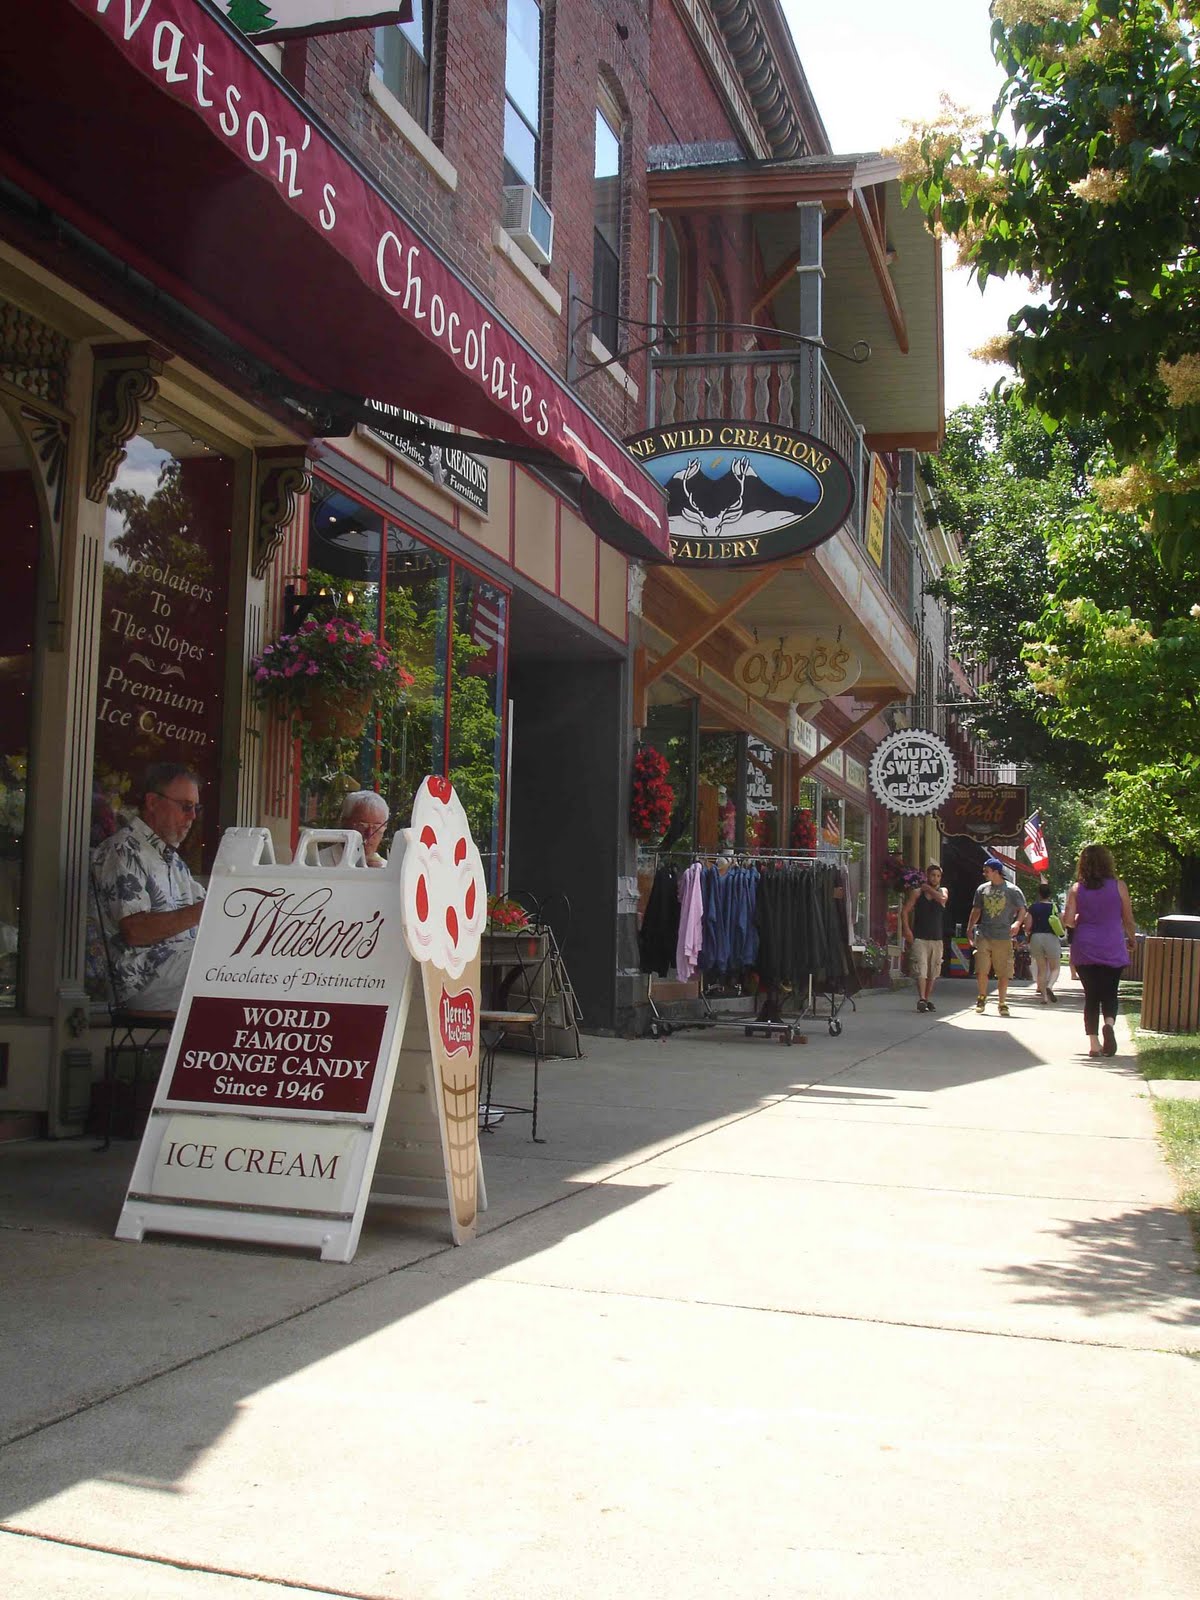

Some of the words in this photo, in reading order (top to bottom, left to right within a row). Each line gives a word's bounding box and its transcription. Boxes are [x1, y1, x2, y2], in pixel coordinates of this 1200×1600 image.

[376, 230, 549, 436] Chocolates
[627, 437, 656, 459] NE
[661, 428, 714, 449] WILD
[719, 426, 832, 474] CREATIONS
[394, 435, 425, 467] Lighting
[449, 474, 484, 507] Furniture
[445, 447, 488, 493] CREATIONS
[668, 537, 761, 560] GALLERY
[151, 590, 171, 617] To
[111, 608, 147, 640] The
[151, 624, 205, 662] Slopes
[104, 666, 205, 714] Premium
[97, 697, 132, 726] Ice
[139, 710, 208, 746] Cream
[886, 760, 940, 775] SWEAT
[893, 748, 932, 760] MUD
[888, 782, 939, 796] GEARS
[223, 886, 385, 959] Watson's
[205, 965, 278, 986] Chocolates
[282, 971, 299, 992] of
[301, 972, 386, 990] Distinction
[242, 1006, 330, 1029] WORLD
[443, 998, 471, 1034] Perry's
[232, 1029, 333, 1054] FAMOUS
[182, 1050, 277, 1075] SPONGE
[281, 1056, 370, 1080] CANDY
[213, 1076, 268, 1098] Since
[273, 1079, 325, 1102] 1946
[164, 1142, 217, 1169] ICE
[224, 1147, 341, 1180] CREAM
